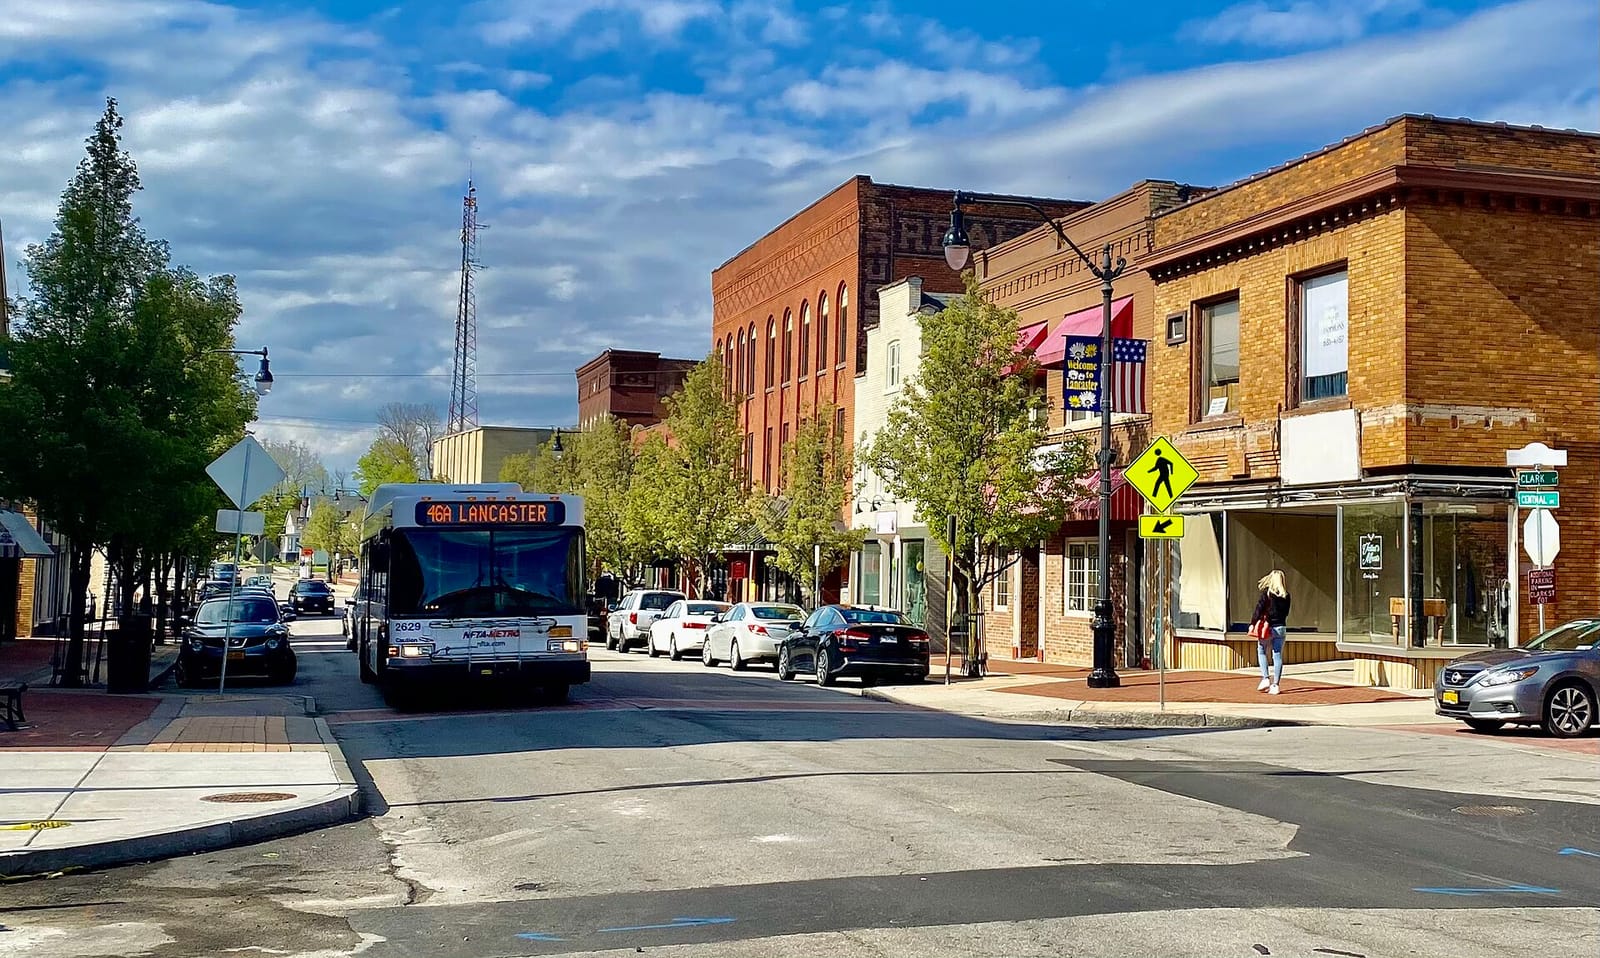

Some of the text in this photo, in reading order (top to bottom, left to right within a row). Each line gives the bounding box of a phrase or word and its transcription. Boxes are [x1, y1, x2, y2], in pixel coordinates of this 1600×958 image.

[1067, 360, 1098, 371] Welcome
[1086, 371, 1095, 379] to
[1066, 377, 1099, 391] Lancaster
[1520, 474, 1545, 484] CLARK
[1521, 495, 1548, 504] CENTRAL
[427, 504, 547, 522] 46A LANCASTER
[395, 622, 421, 632] 2629
